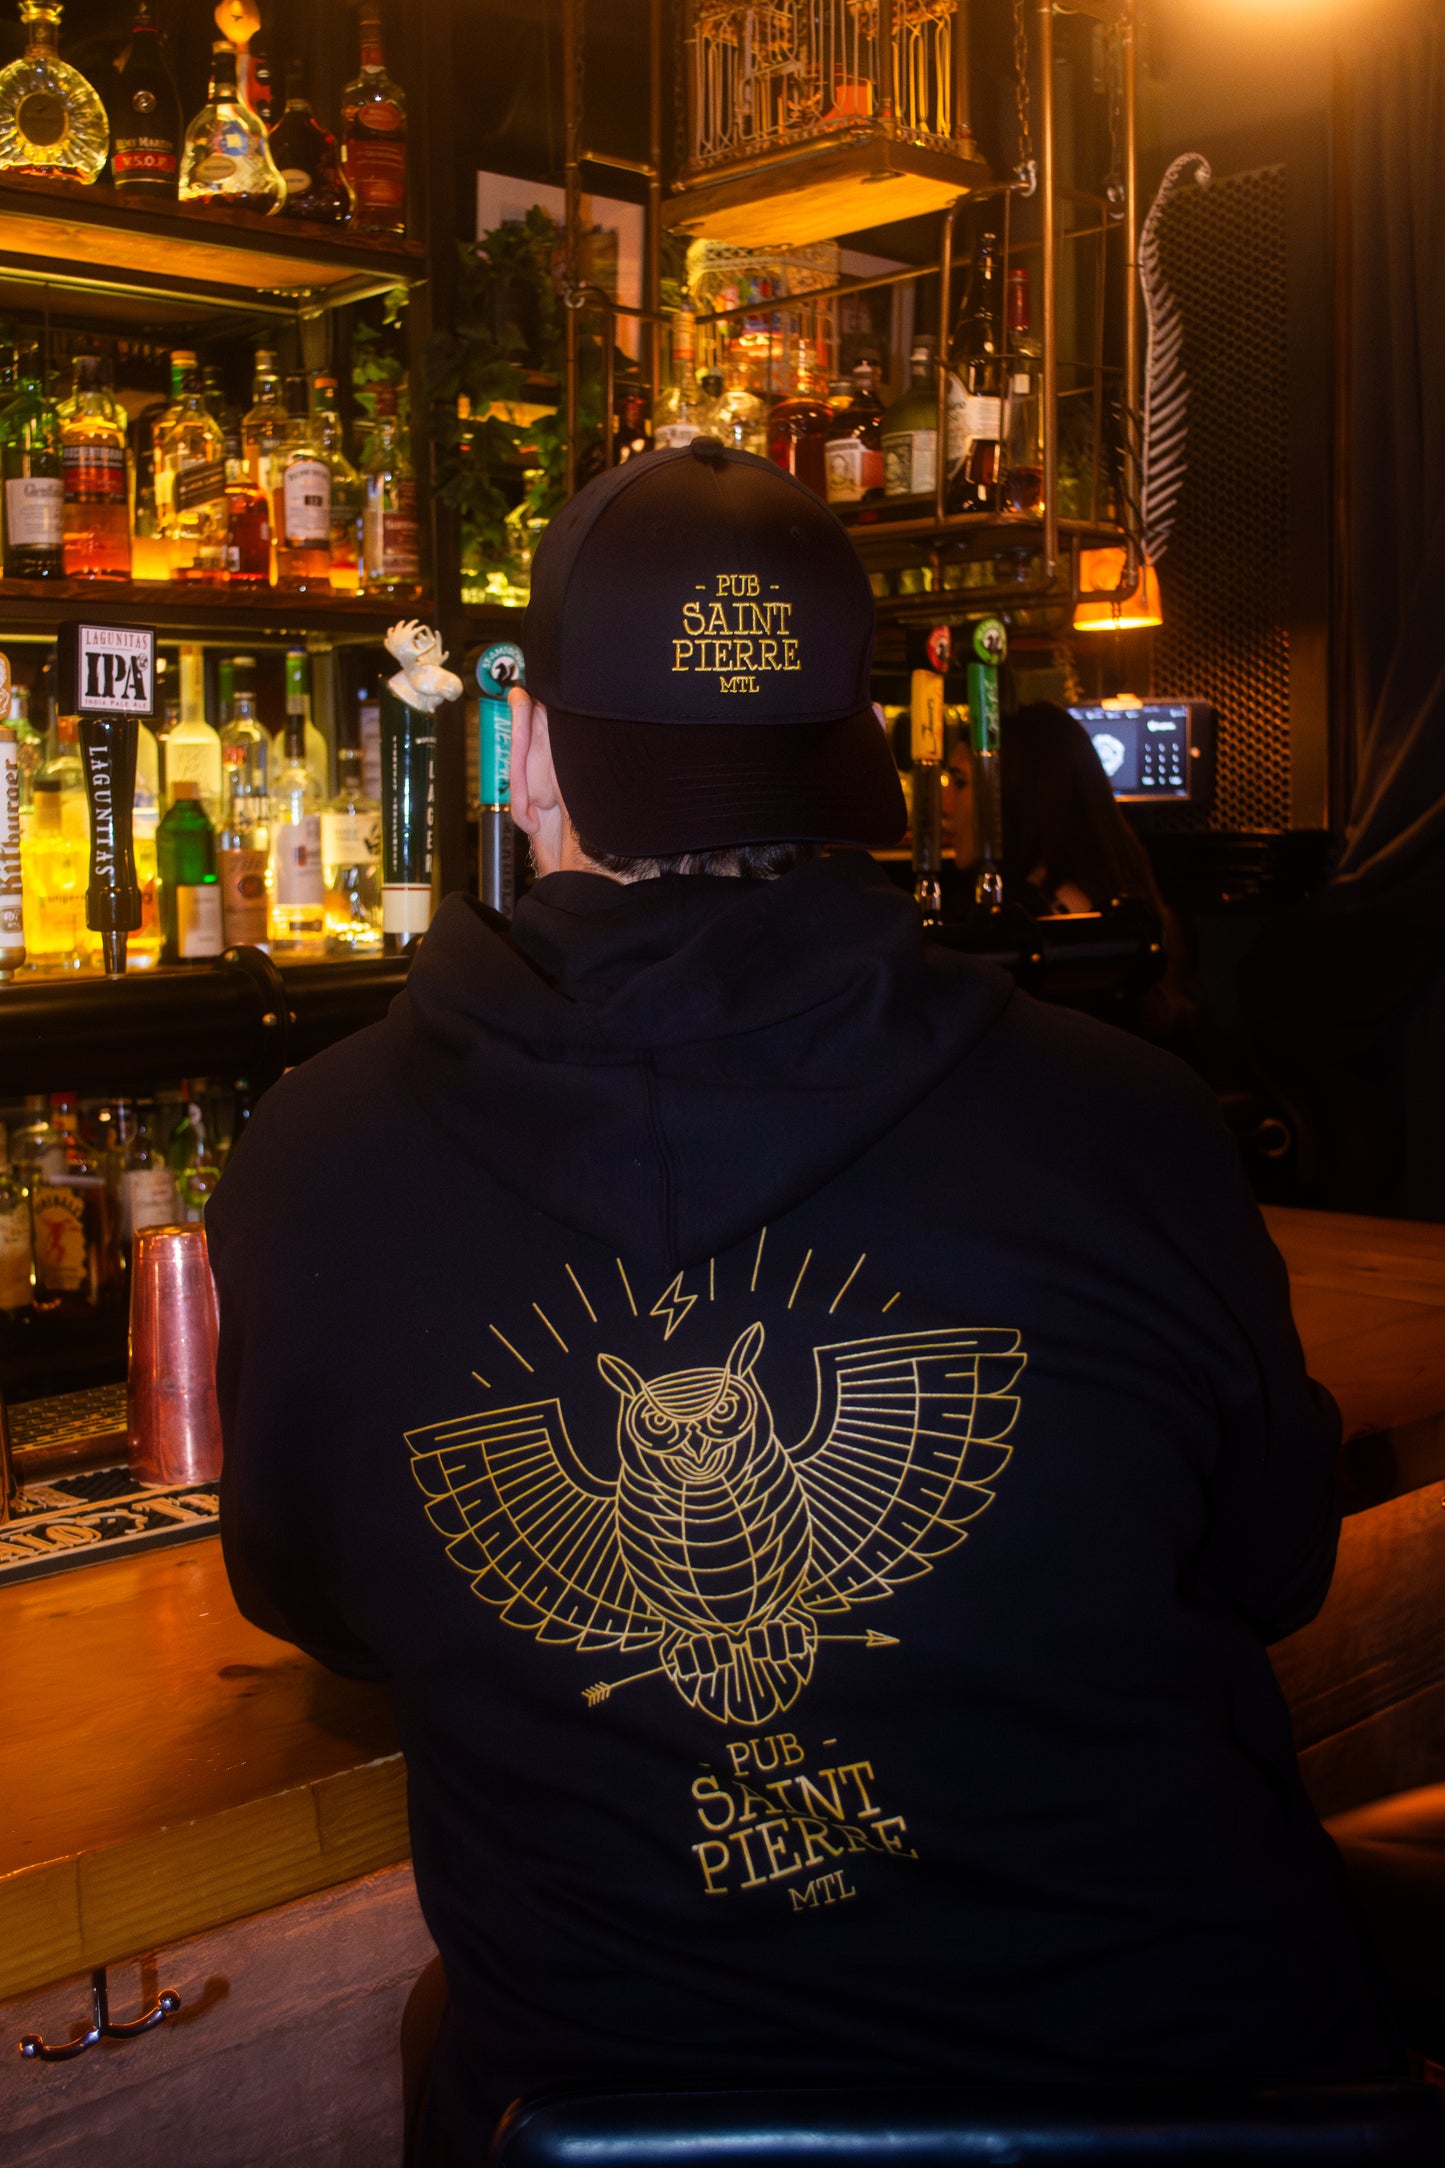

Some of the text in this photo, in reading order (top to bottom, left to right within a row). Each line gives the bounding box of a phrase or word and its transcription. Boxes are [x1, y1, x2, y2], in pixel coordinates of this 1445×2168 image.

[716, 574, 760, 597] PUB
[86, 629, 149, 651] LAGUNITAS
[682, 601, 793, 636] SAINT
[85, 651, 147, 701] IPA
[671, 638, 802, 672] PIERRE
[719, 675, 760, 693] MTL
[89, 745, 116, 877] LAGUNITAS
[424, 759, 436, 874] LAGER
[726, 1732, 806, 1777] PUB
[691, 1760, 882, 1832] SAINT
[691, 1815, 920, 1895] PIERRE
[788, 1870, 857, 1912] MTL
